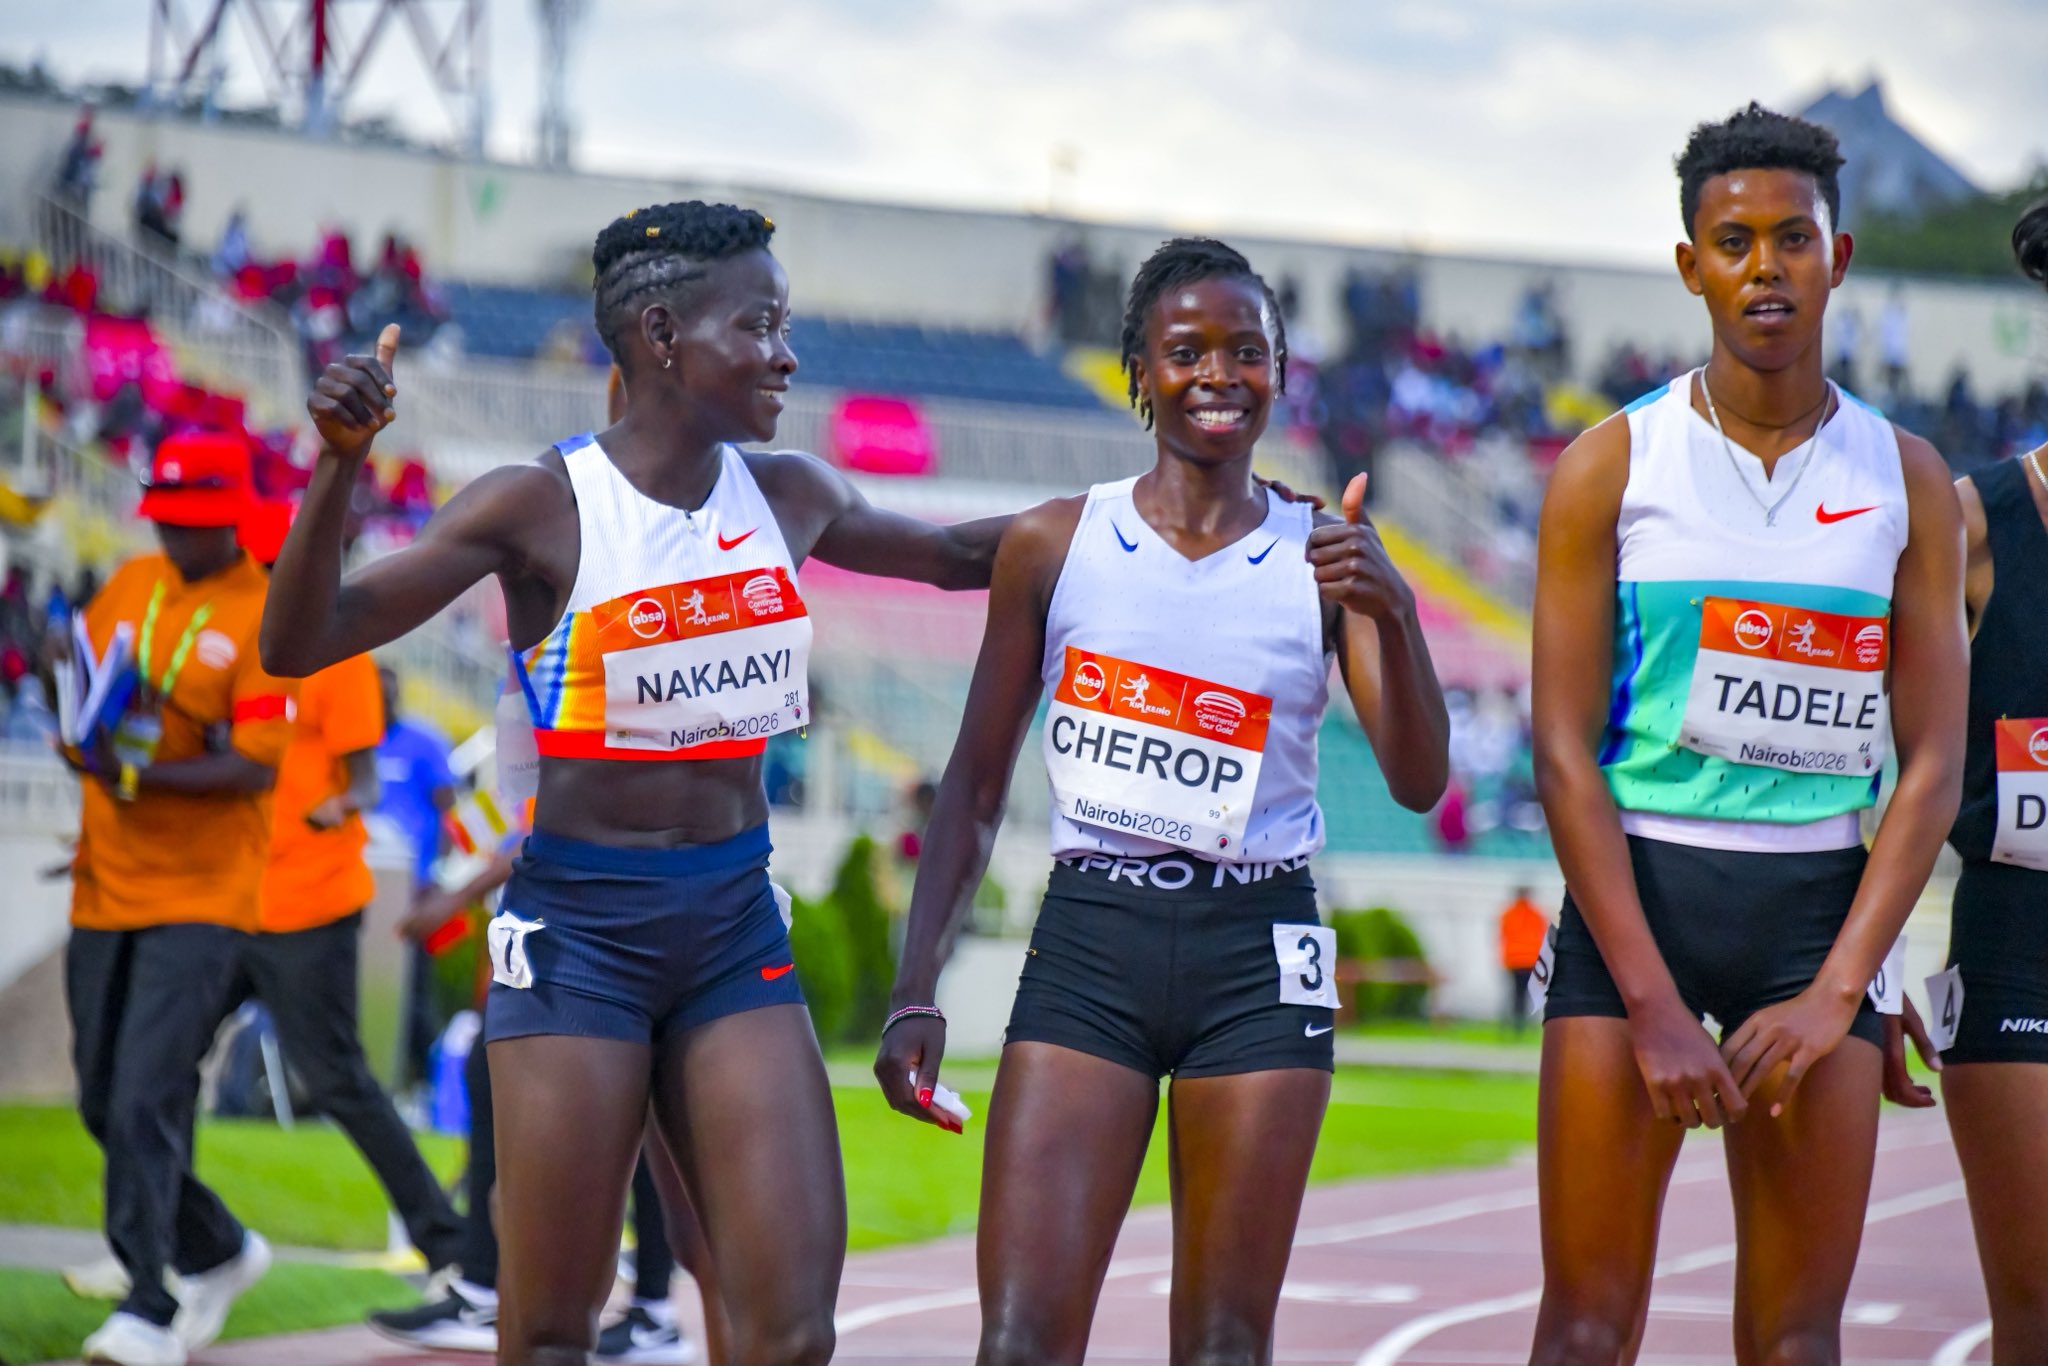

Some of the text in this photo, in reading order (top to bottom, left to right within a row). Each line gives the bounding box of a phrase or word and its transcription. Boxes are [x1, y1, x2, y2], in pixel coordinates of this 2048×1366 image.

[633, 609, 662, 626] absa
[753, 608, 768, 617] Tour
[1739, 620, 1769, 637] absa
[637, 648, 791, 705] NAKAAYI
[1075, 672, 1102, 690] absa
[784, 690, 800, 707] 281
[1714, 673, 1879, 730] TADELE
[670, 712, 780, 748] Nairobi2026
[1195, 709, 1240, 728] Continental
[1198, 719, 1234, 736] Tour Gold
[1051, 715, 1244, 794] CHEROP
[1739, 743, 1847, 771] Nairobi2026
[1857, 742, 1871, 753] 44
[1074, 797, 1192, 842] Nairobi2026
[1208, 808, 1221, 819] 99
[1079, 855, 1194, 890] PRO
[1297, 936, 1323, 991] 3
[1942, 981, 1957, 1036] 4
